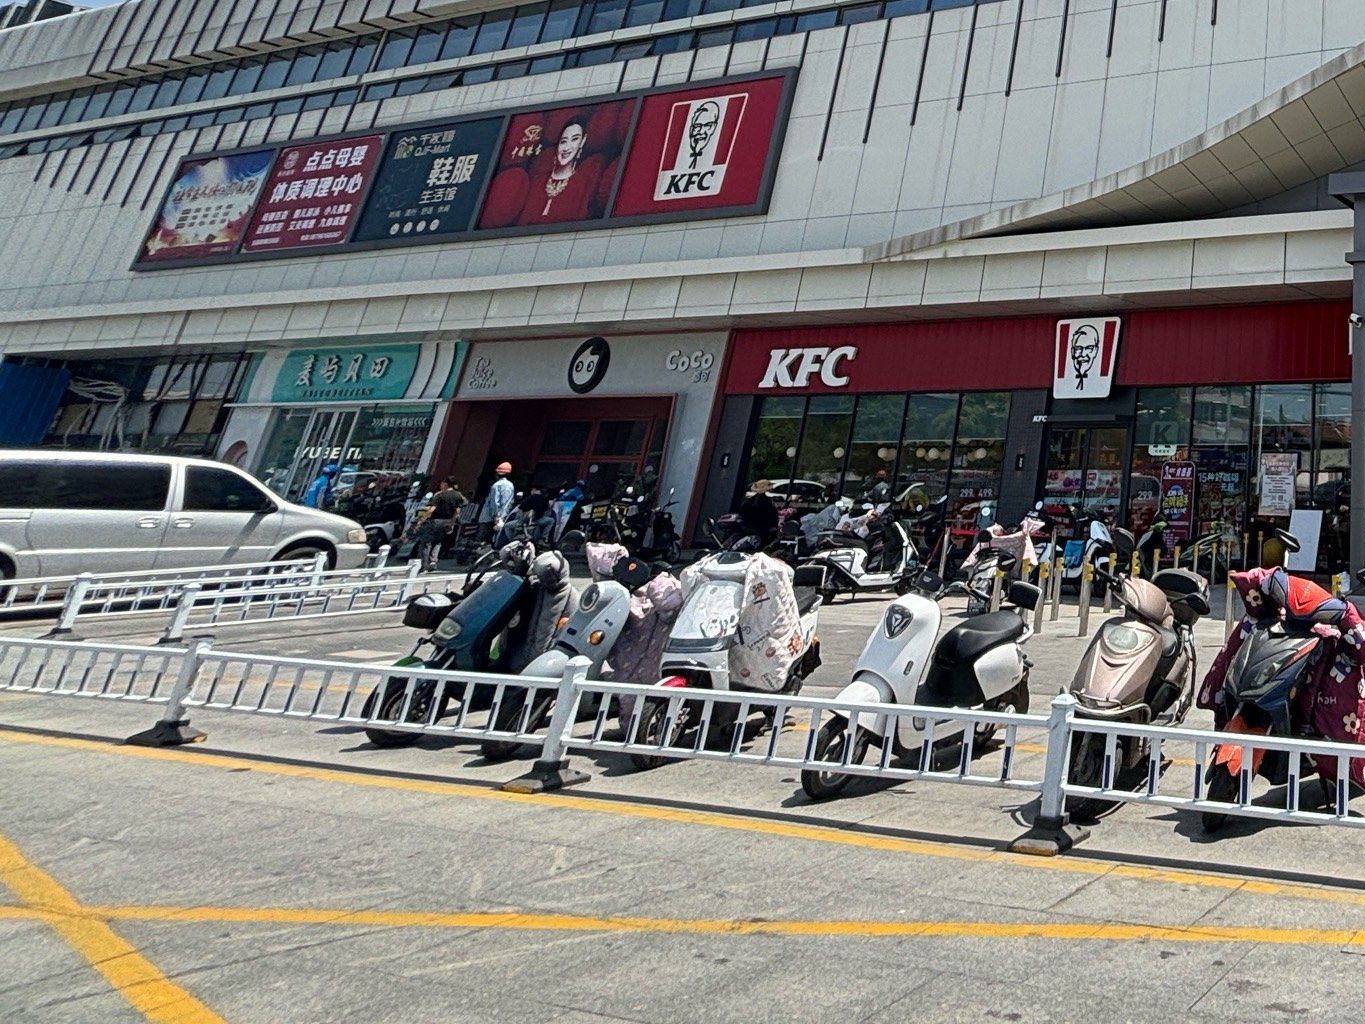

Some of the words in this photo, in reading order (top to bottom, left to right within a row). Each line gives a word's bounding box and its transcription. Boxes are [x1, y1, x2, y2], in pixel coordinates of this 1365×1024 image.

[427, 154, 479, 187] 鞋服
[663, 170, 715, 194] KFC
[269, 172, 364, 204] 体质调理中心
[419, 187, 458, 204] 生活馆
[666, 350, 714, 373] CoCo
[758, 346, 858, 388] KFC
[1032, 415, 1048, 423] KFC
